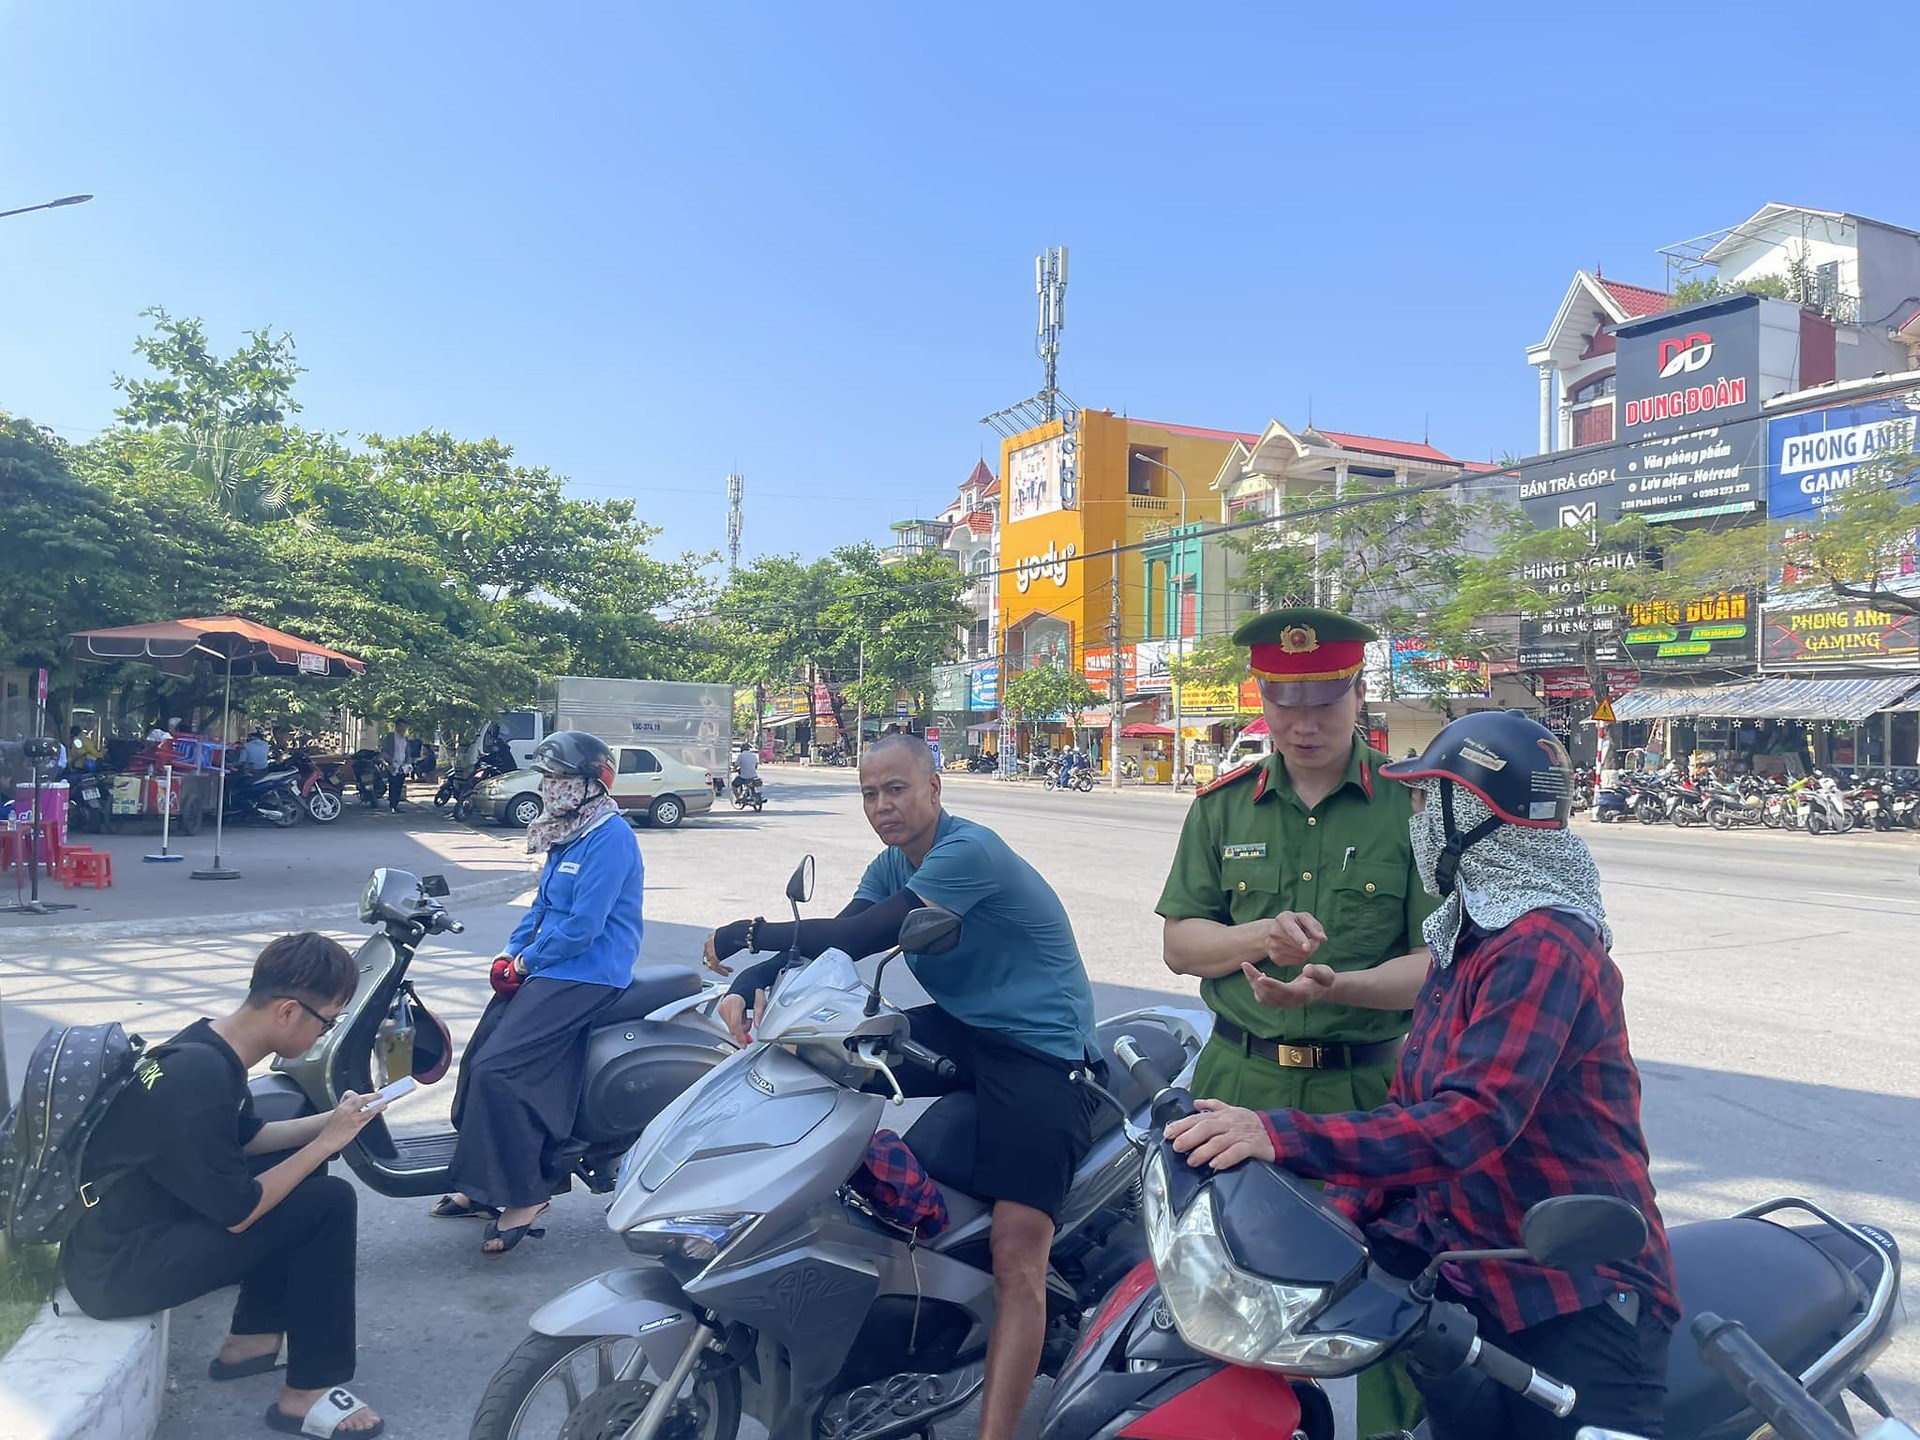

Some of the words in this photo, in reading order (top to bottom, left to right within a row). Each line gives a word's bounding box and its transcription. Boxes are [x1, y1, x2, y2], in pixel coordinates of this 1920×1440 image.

[1626, 391, 1684, 426] DUNG
[1685, 377, 1747, 415] ĐOÀN
[1788, 432, 1857, 467] PHONG
[1520, 480, 1547, 498] BÁN
[1549, 473, 1577, 494] TRẢ
[1579, 468, 1609, 488] GÓP
[1016, 540, 1068, 594] yody
[1791, 612, 1849, 631] PHONG
[1804, 631, 1883, 653] GAMING
